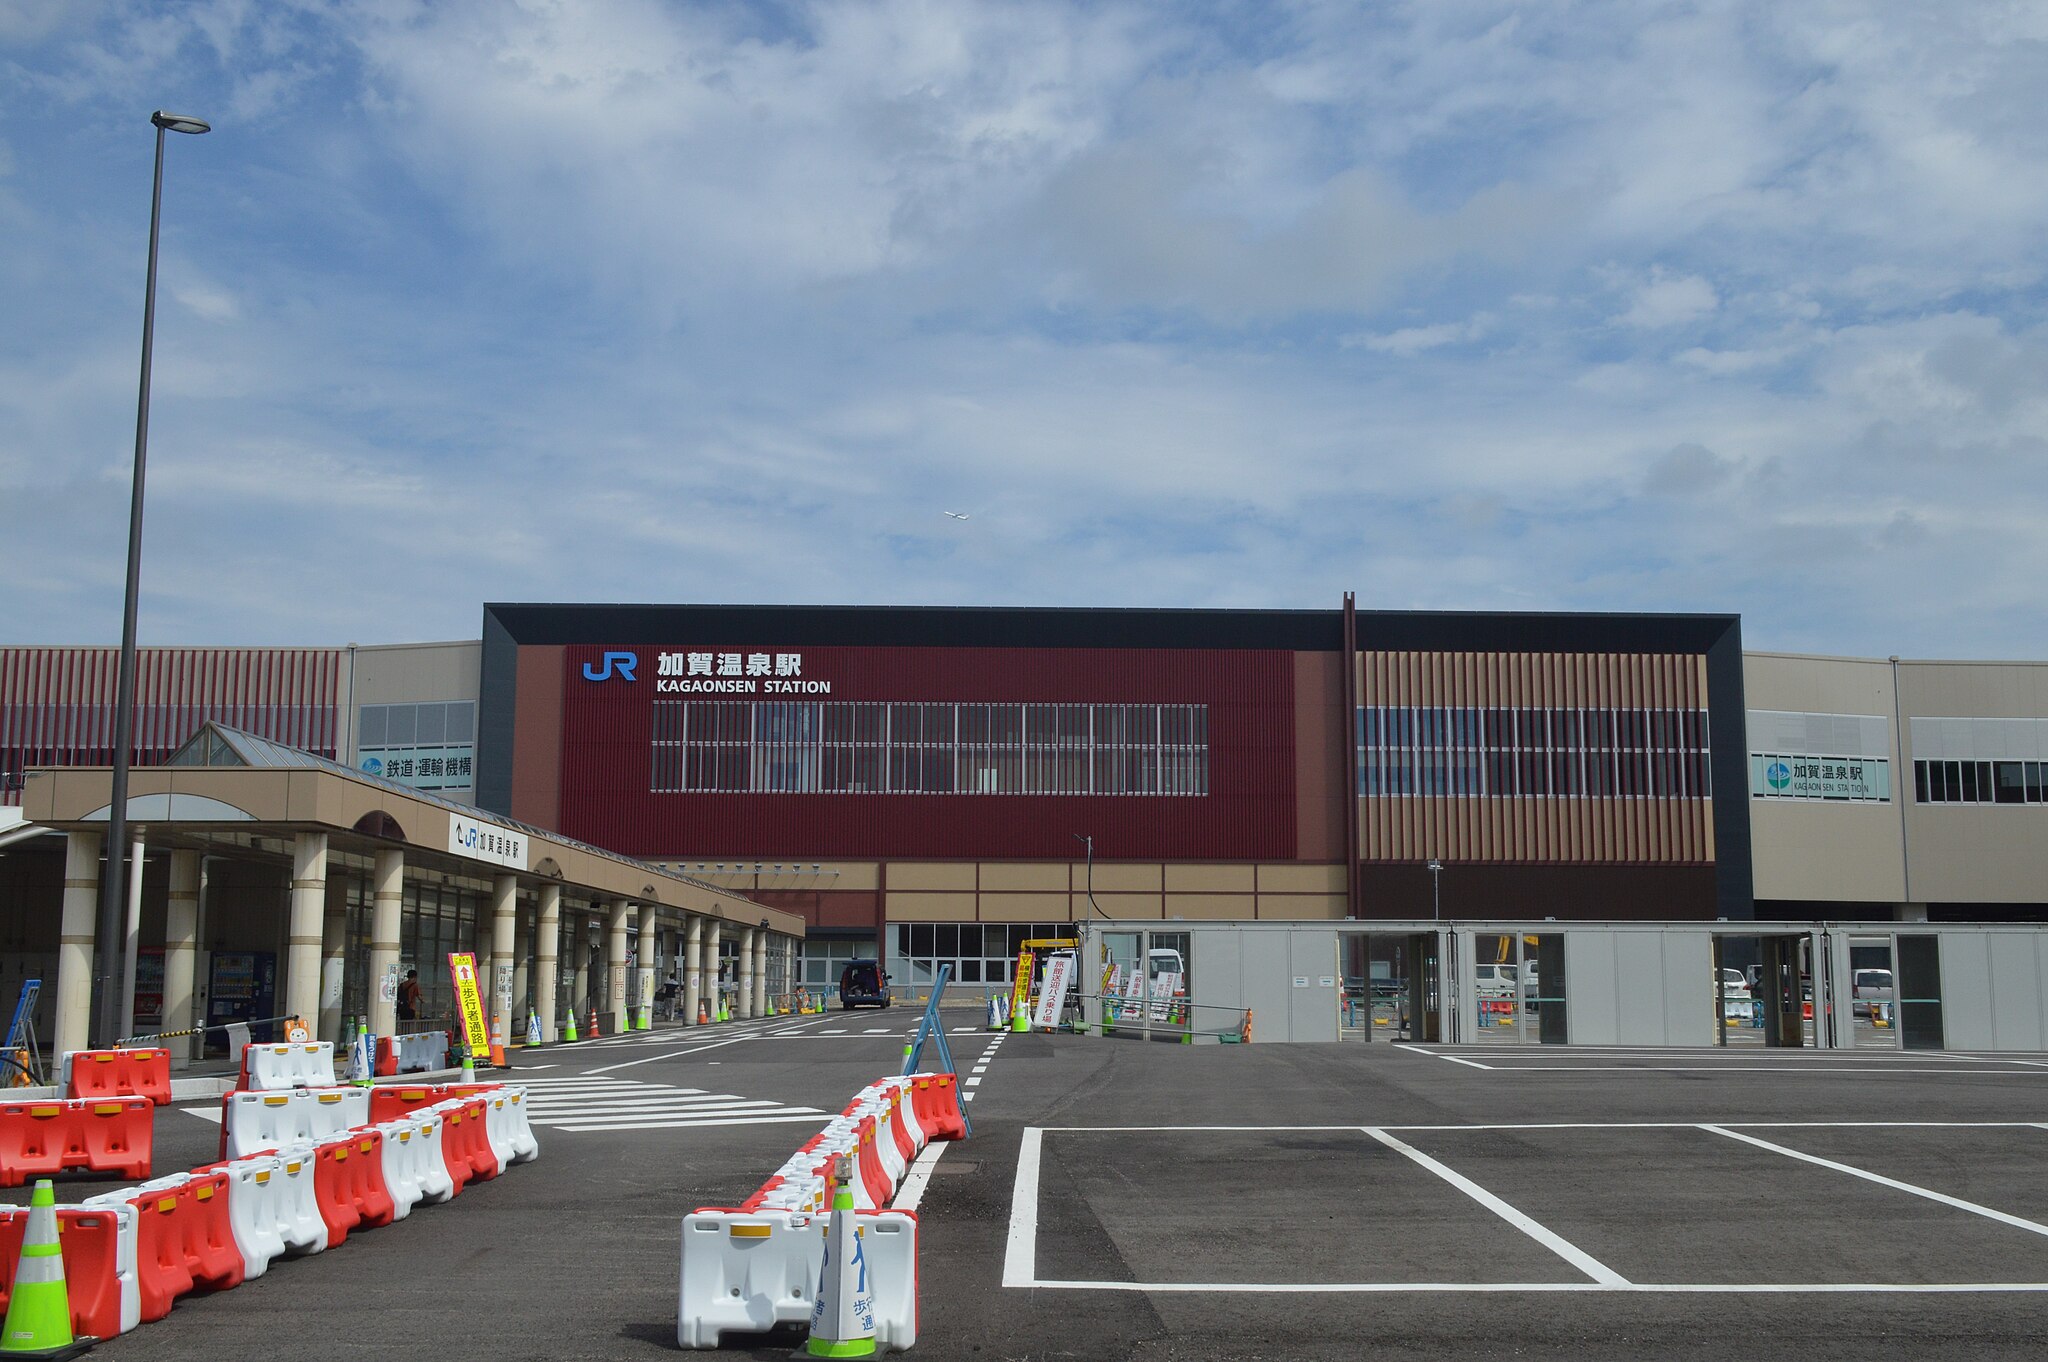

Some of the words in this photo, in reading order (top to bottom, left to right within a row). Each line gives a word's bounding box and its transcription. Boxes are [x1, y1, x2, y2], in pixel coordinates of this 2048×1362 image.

[582, 651, 638, 681] JR
[657, 652, 802, 677] 加賀温泉駅
[657, 679, 756, 693] KAGAONSEN
[764, 680, 831, 694] STATION
[1793, 764, 1862, 780] 加賀温泉駅
[1837, 784, 1869, 793] STATION
[465, 827, 477, 849] JR
[1042, 960, 1065, 1023] 旅館送迎バス乗り場
[462, 987, 484, 1045] 歩行者通路
